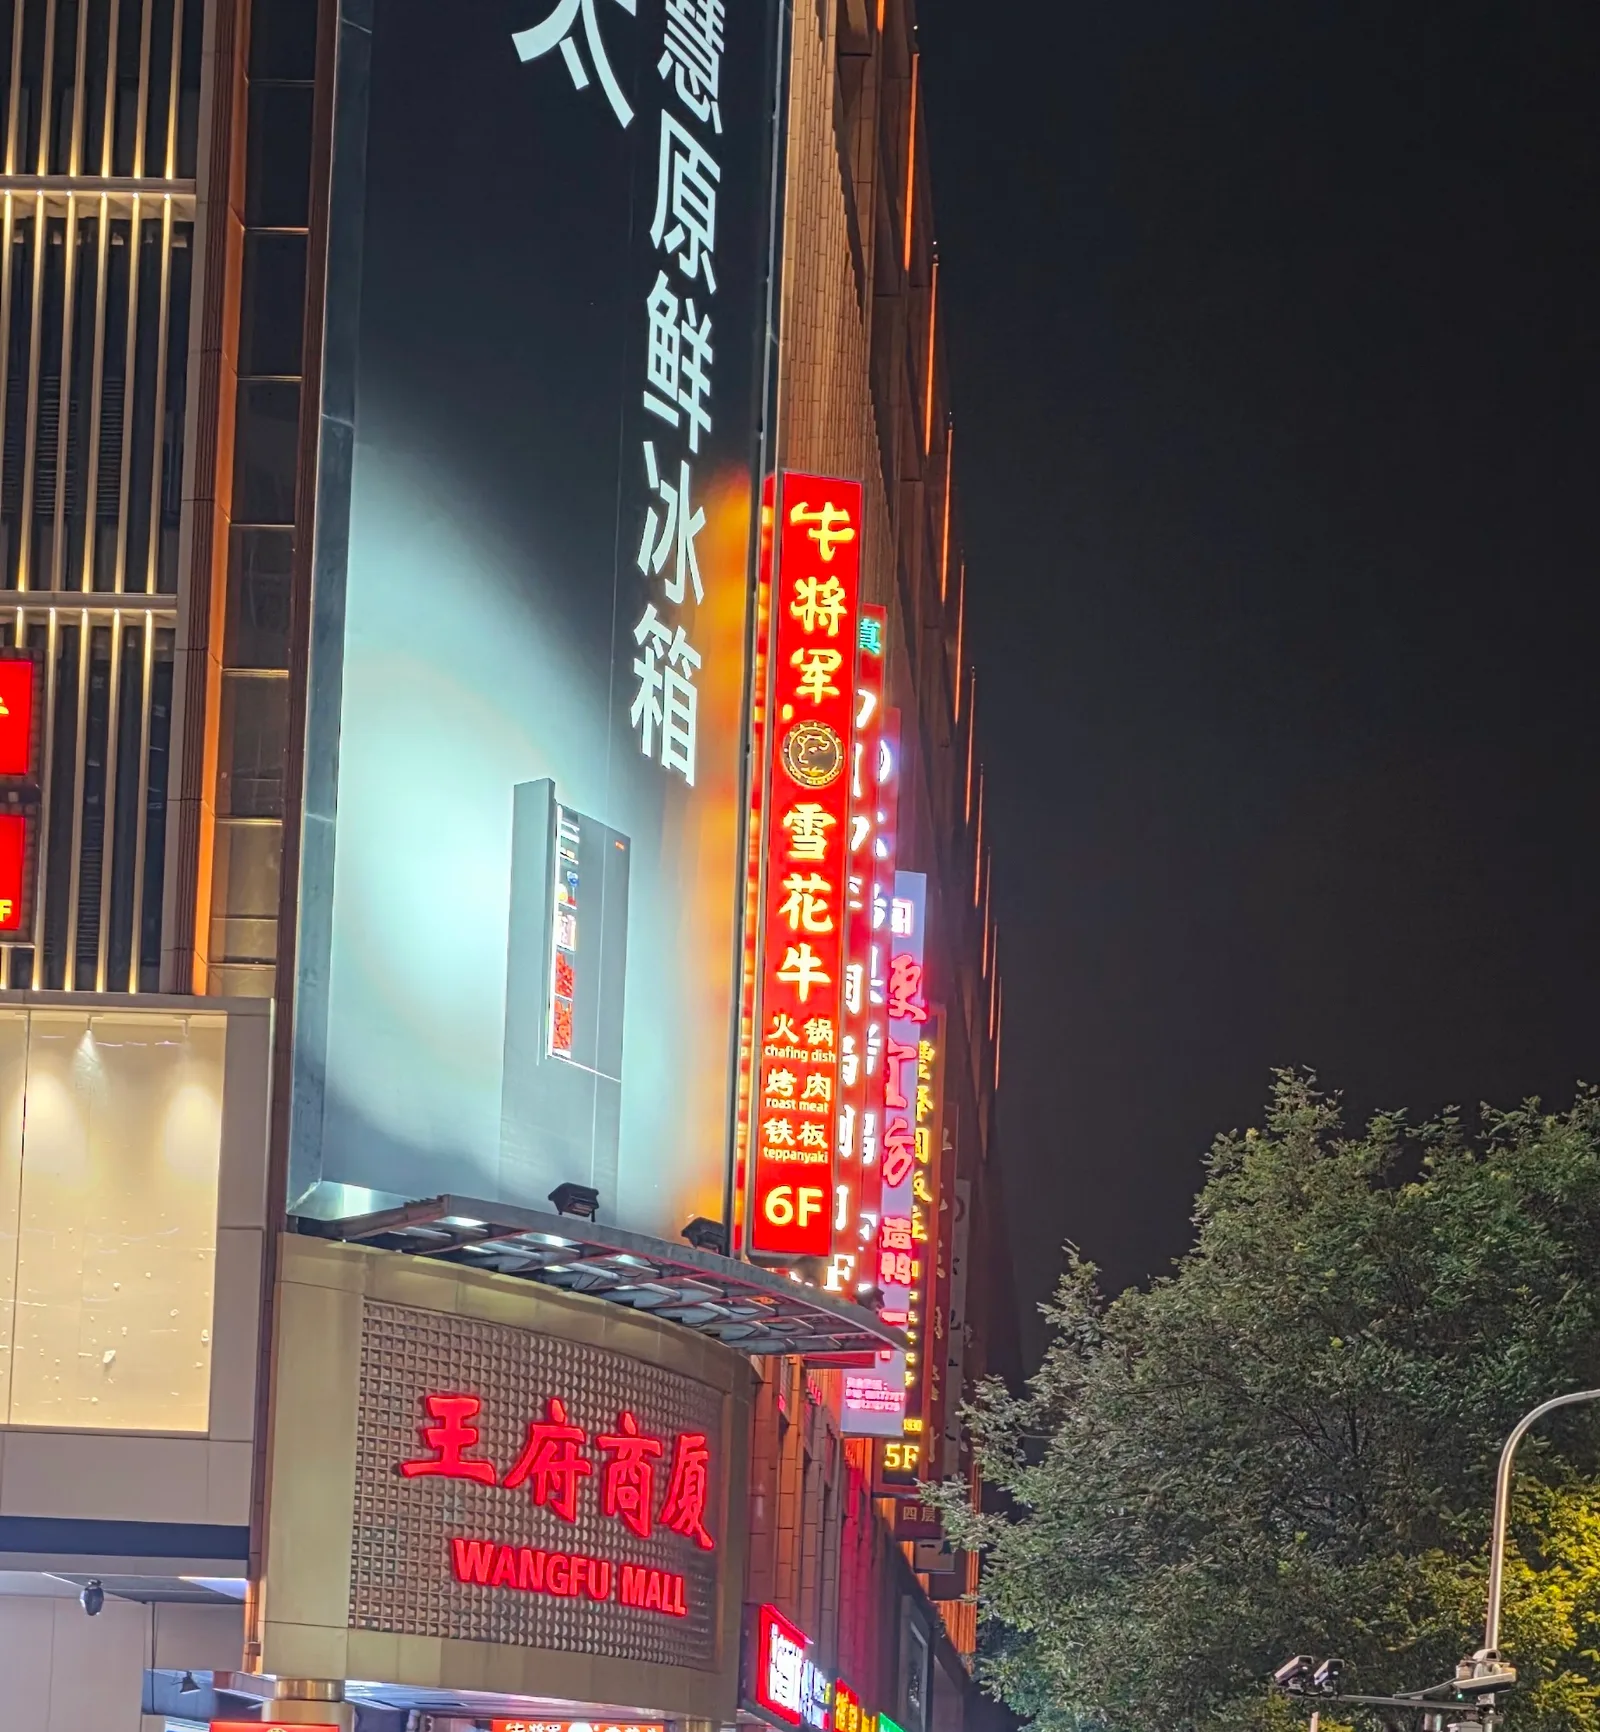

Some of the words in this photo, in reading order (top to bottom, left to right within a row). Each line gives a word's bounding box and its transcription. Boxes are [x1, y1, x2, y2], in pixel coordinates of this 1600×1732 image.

[776, 803, 837, 1003] 雪花牛
[768, 1013, 834, 1047] 火锅
[764, 1043, 808, 1063] chafing
[811, 1048, 836, 1063] dish
[765, 1068, 831, 1102] 烤肉
[765, 1096, 797, 1111] roast
[799, 1100, 829, 1114] meat
[763, 1117, 828, 1149] 铁板
[763, 1146, 829, 1164] teppanyaki
[765, 1185, 824, 1227] 6F
[884, 1442, 921, 1470] 5F
[401, 1395, 715, 1551] 王府商厦
[903, 1506, 935, 1523] 四层
[452, 1538, 612, 1602] WANGFU
[620, 1564, 688, 1617] MALL
